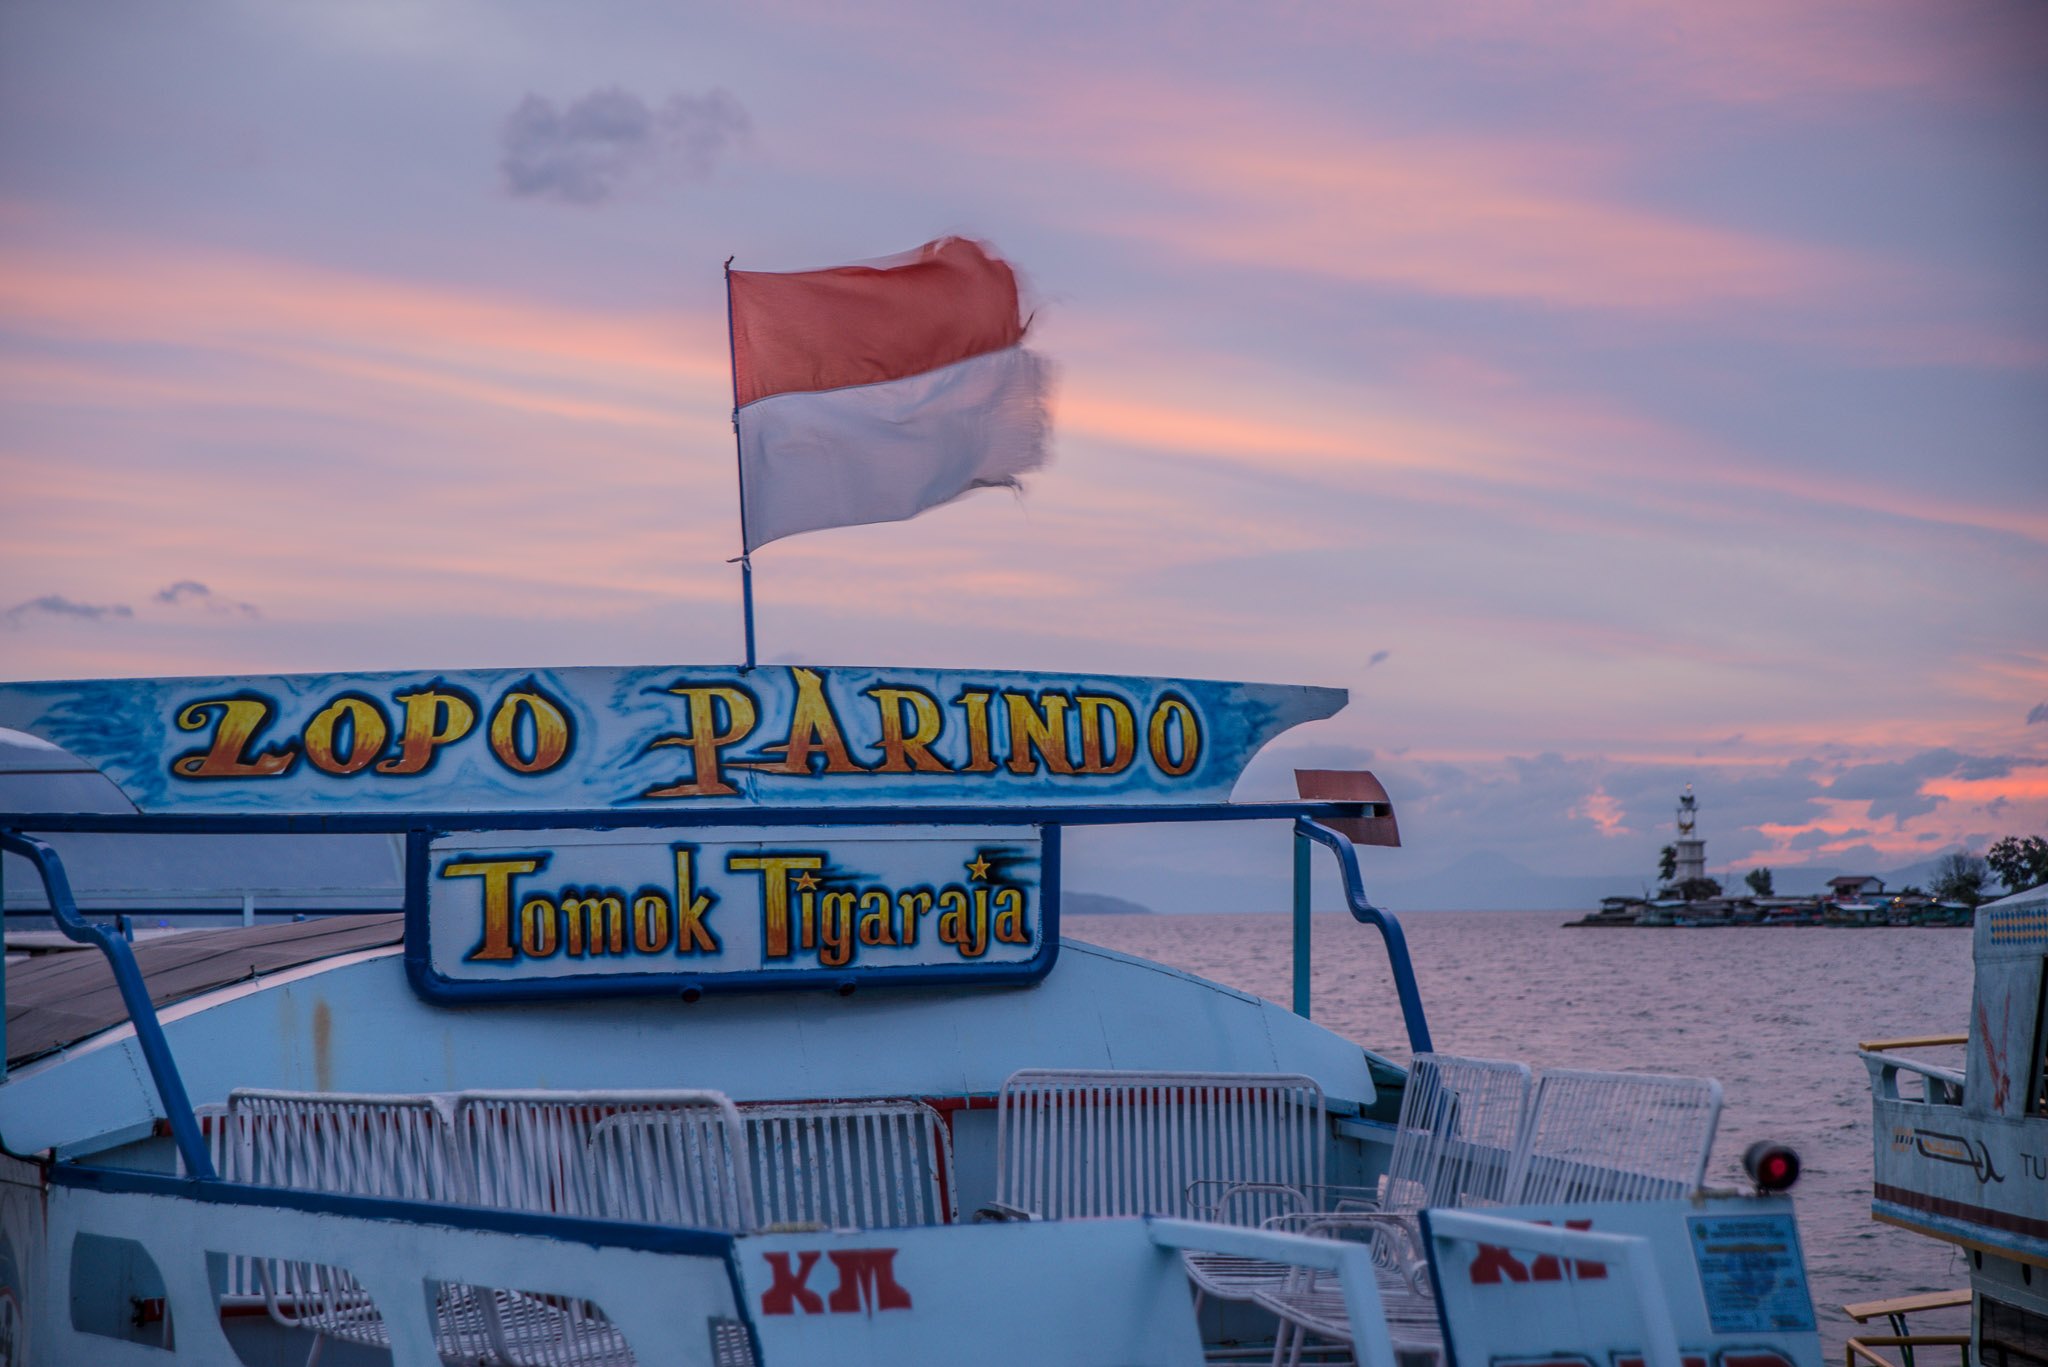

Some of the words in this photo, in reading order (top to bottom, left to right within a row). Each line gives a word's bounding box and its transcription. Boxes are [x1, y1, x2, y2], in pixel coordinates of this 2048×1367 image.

[644, 667, 1201, 797] PARINDO
[444, 850, 717, 960] Tomok
[729, 856, 1030, 966] Tigaraja
[761, 1248, 912, 1318] KM
